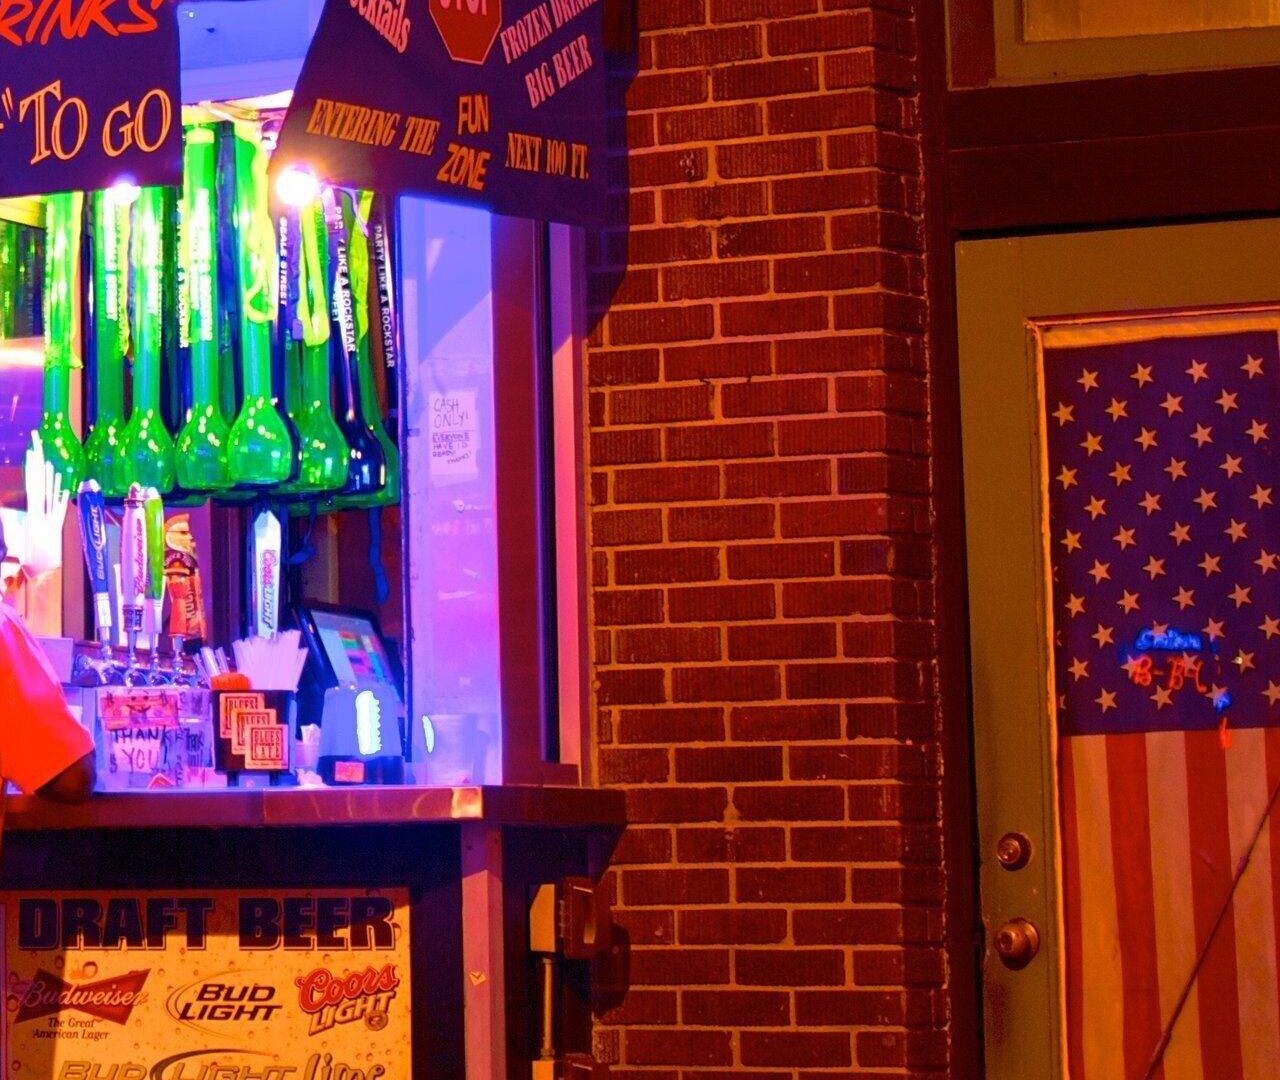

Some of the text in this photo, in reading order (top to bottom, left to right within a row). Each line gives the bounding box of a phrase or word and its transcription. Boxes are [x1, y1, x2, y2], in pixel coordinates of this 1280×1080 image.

[524, 34, 593, 109] BIG BEER
[17, 80, 88, 165] TO
[101, 88, 172, 160] GO
[306, 98, 400, 147] ENTERING
[399, 115, 440, 157] THE
[457, 94, 489, 135] FUN
[505, 132, 542, 172] NEXT
[545, 140, 568, 176] 100
[436, 143, 491, 191] ZONE
[374, 224, 385, 262] PARTY
[378, 264, 387, 291] LIKE
[341, 289, 355, 352] ROCKSTAR
[381, 307, 395, 368] ROCKSTAR
[433, 398, 459, 413] CASH
[90, 506, 100, 540] LIGHT
[261, 584, 275, 630] LIGHT
[17, 896, 396, 951] DRAFT BEER
[18, 979, 149, 1010] Budweiser
[195, 983, 277, 1002] BUD
[296, 964, 399, 1014] Coors
[32, 1028, 111, 1041] American Lager
[47, 1017, 94, 1028] The Great
[179, 1005, 283, 1021] LIGHT
[308, 990, 397, 1037] LIGHT
